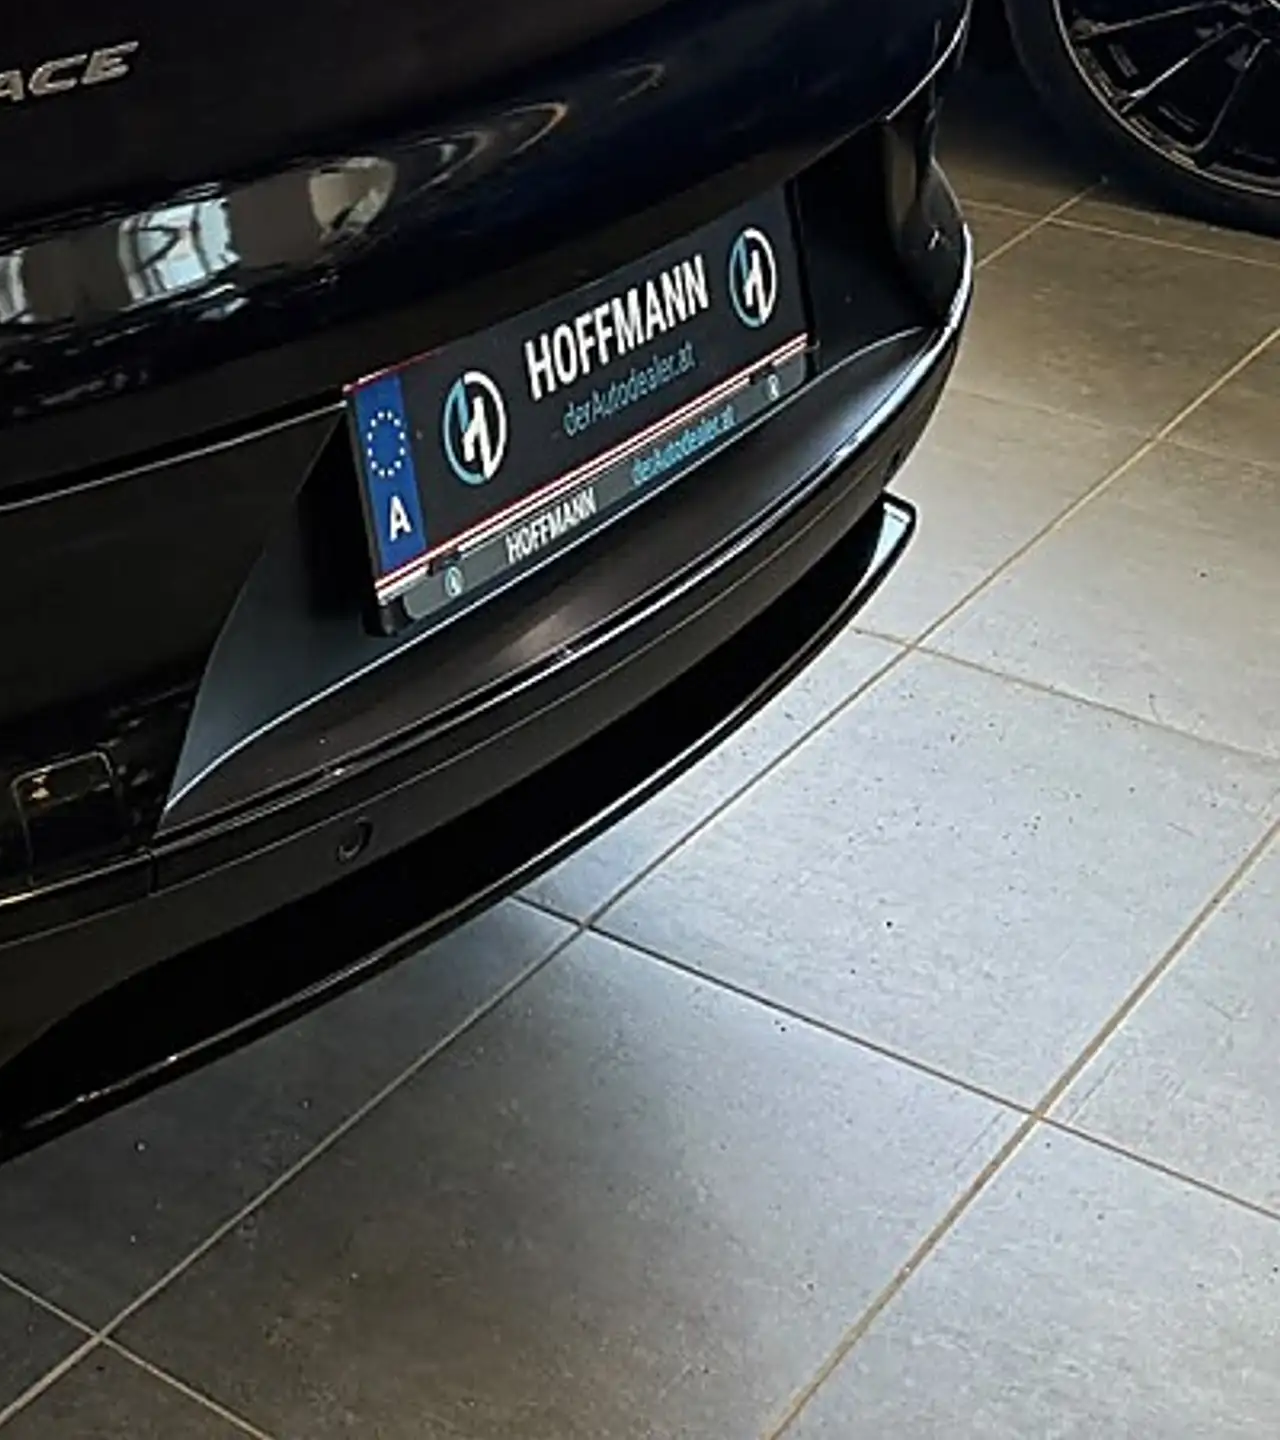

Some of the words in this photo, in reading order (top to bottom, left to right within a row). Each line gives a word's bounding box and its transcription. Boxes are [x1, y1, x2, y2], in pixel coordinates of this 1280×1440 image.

[524, 253, 709, 402] HOFFMANN
[388, 495, 412, 542] A
[504, 485, 598, 564] HOFFMANN
